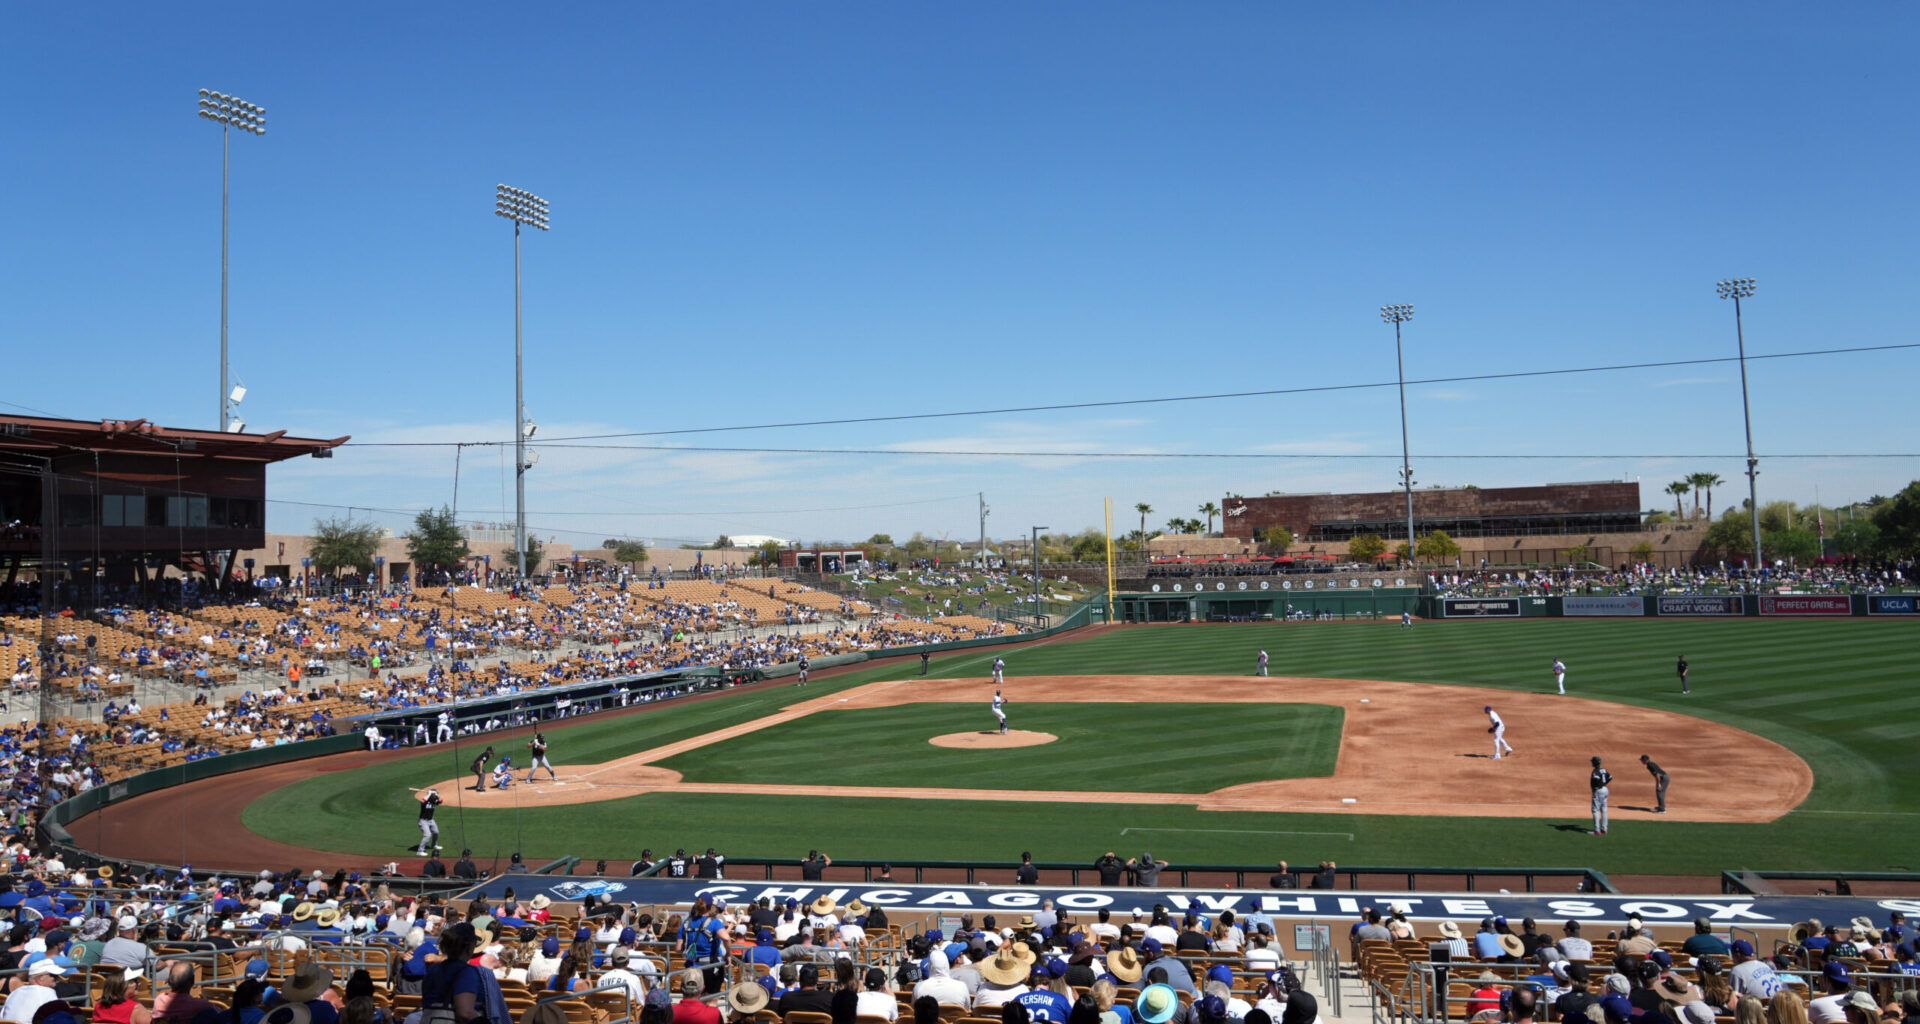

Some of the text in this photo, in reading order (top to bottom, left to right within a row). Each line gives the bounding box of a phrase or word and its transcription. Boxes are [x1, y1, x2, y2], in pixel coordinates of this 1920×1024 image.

[1777, 601, 1809, 609] PERFECT
[1810, 601, 1834, 609] GAME
[1881, 600, 1909, 609] UCLA
[672, 865, 684, 876] 38
[693, 886, 1775, 919] CHICAGO WHITE SOX
[1019, 994, 1055, 1006] KERSHAW
